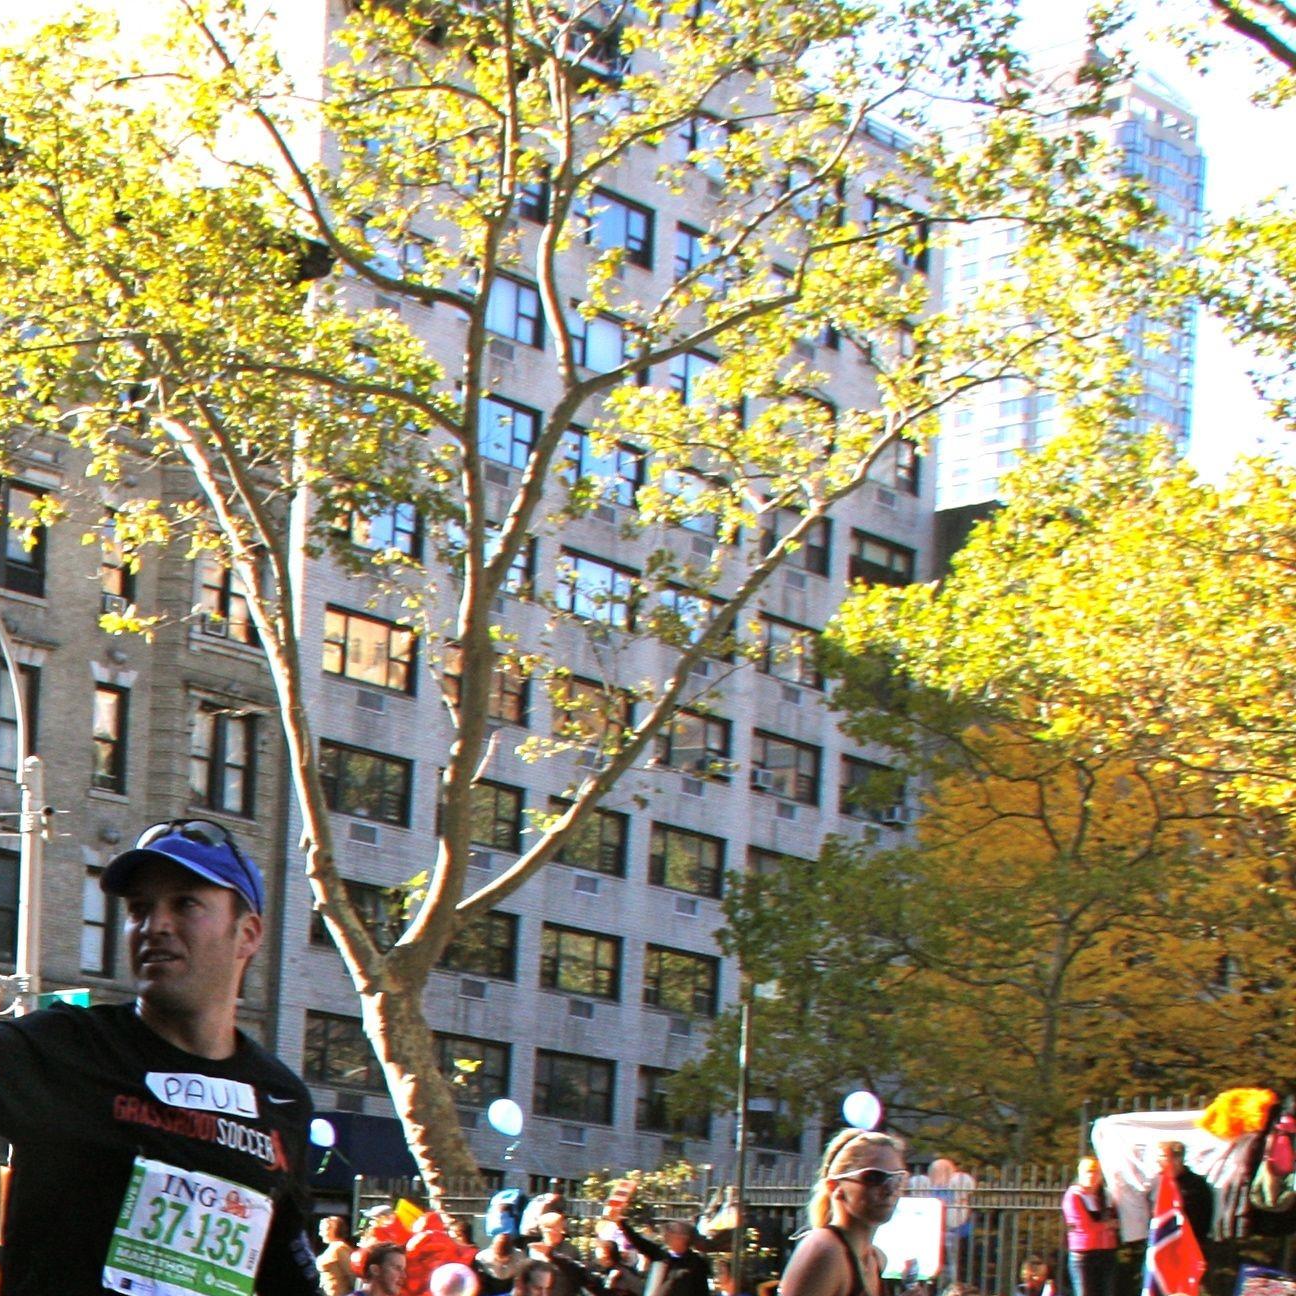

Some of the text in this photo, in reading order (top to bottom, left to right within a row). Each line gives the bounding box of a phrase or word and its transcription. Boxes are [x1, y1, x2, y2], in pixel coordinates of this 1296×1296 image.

[164, 1077, 255, 1114] PAUL
[161, 1173, 218, 1208] ING
[141, 1196, 251, 1267] 37-135
